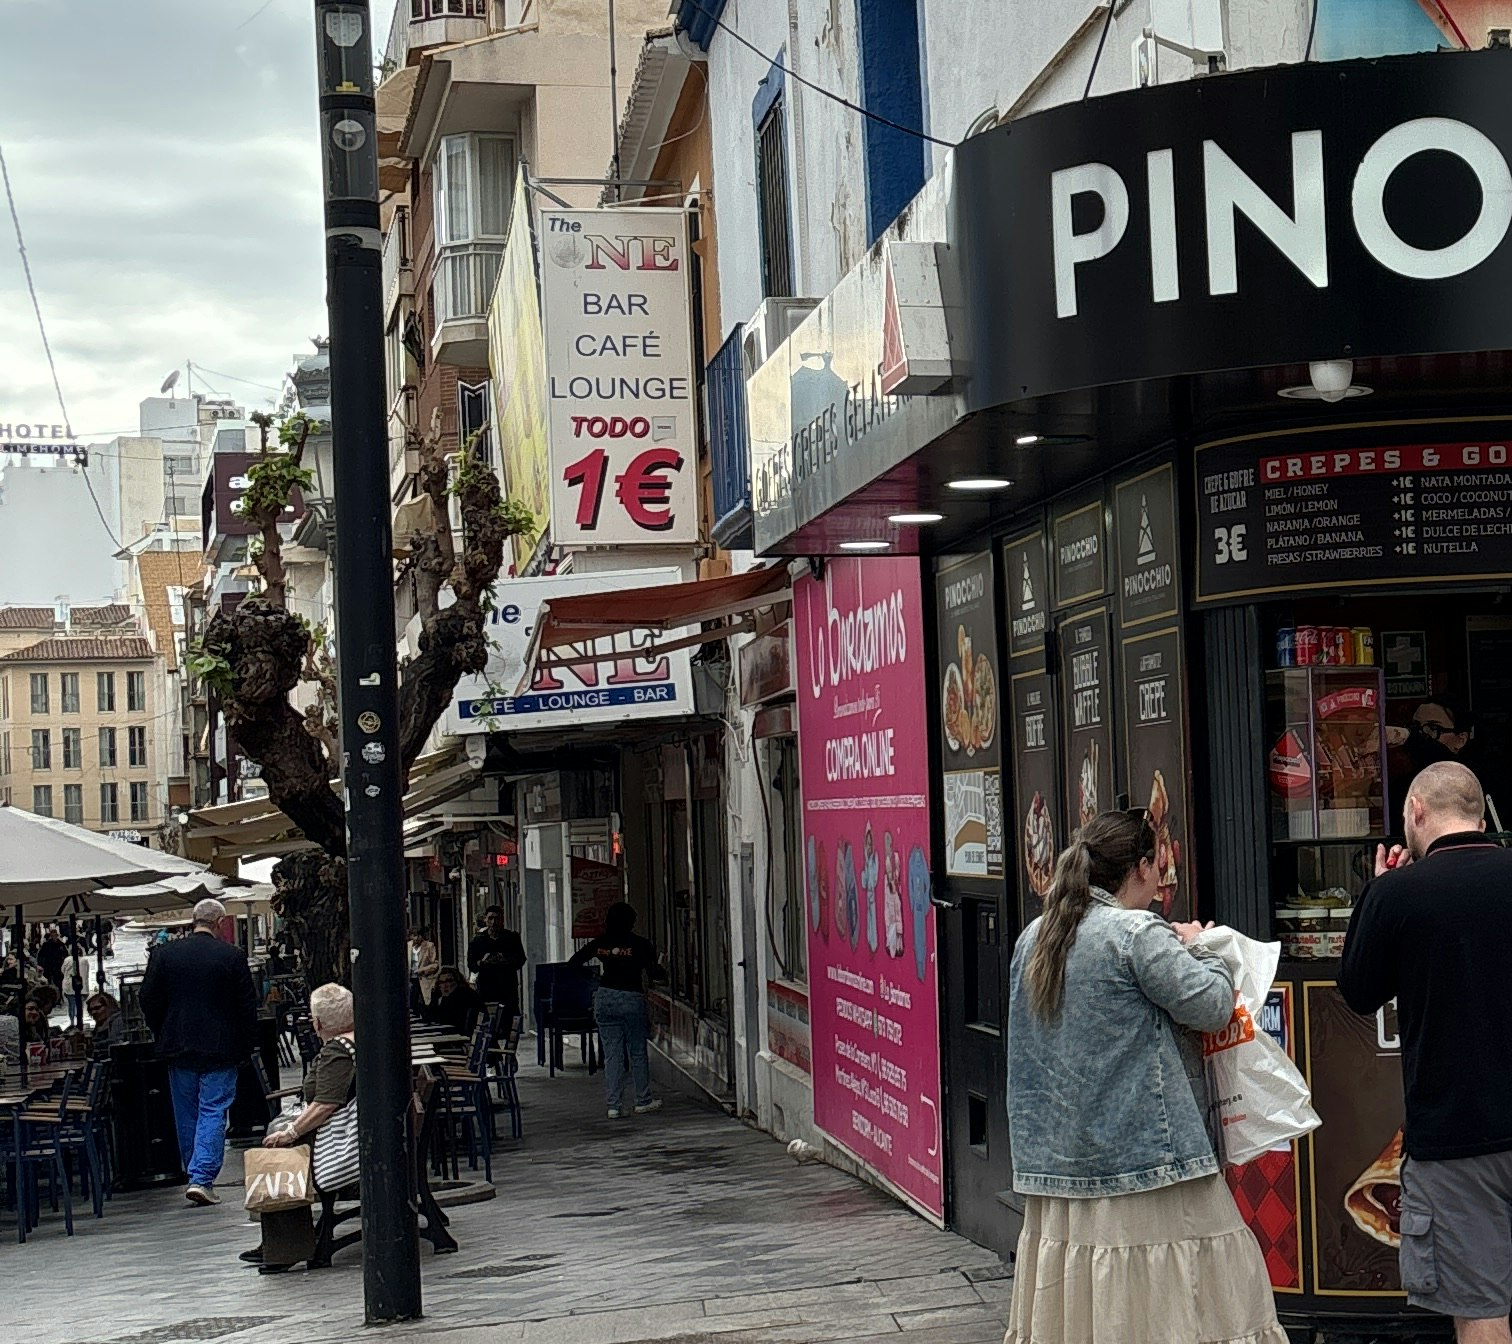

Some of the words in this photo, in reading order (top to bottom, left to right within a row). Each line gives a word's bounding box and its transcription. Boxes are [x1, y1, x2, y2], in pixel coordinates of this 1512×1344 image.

[549, 218, 582, 233] The
[583, 293, 650, 316] BAR
[575, 331, 662, 358] CAFÉ
[550, 377, 689, 400] LOUNGE
[571, 417, 650, 438] TODO
[1265, 450, 1401, 479] CREPES
[1422, 448, 1440, 467] &
[563, 448, 684, 532] 1€
[1265, 488, 1286, 501] MIEL
[1293, 484, 1329, 497] HONEY
[1391, 476, 1414, 489] +1€
[1420, 476, 1451, 488] NATA
[1301, 499, 1338, 513] LEMON
[1392, 492, 1414, 505] +1€
[1421, 492, 1451, 505] COCO
[1393, 510, 1415, 522] +1€
[1422, 507, 1504, 522] MERMELADAS
[1316, 530, 1365, 544] BANANA
[1393, 525, 1416, 538] +1€
[1423, 524, 1461, 538] DULCE
[1462, 524, 1478, 536] DE
[1214, 523, 1248, 565] 3€
[1394, 542, 1416, 556] +1€
[1423, 542, 1479, 555] NUTELLA
[1124, 563, 1172, 598] PINOCCHIO
[538, 692, 611, 709] LOUNGE
[634, 687, 669, 702] BAR
[826, 735, 861, 783] COMPRA
